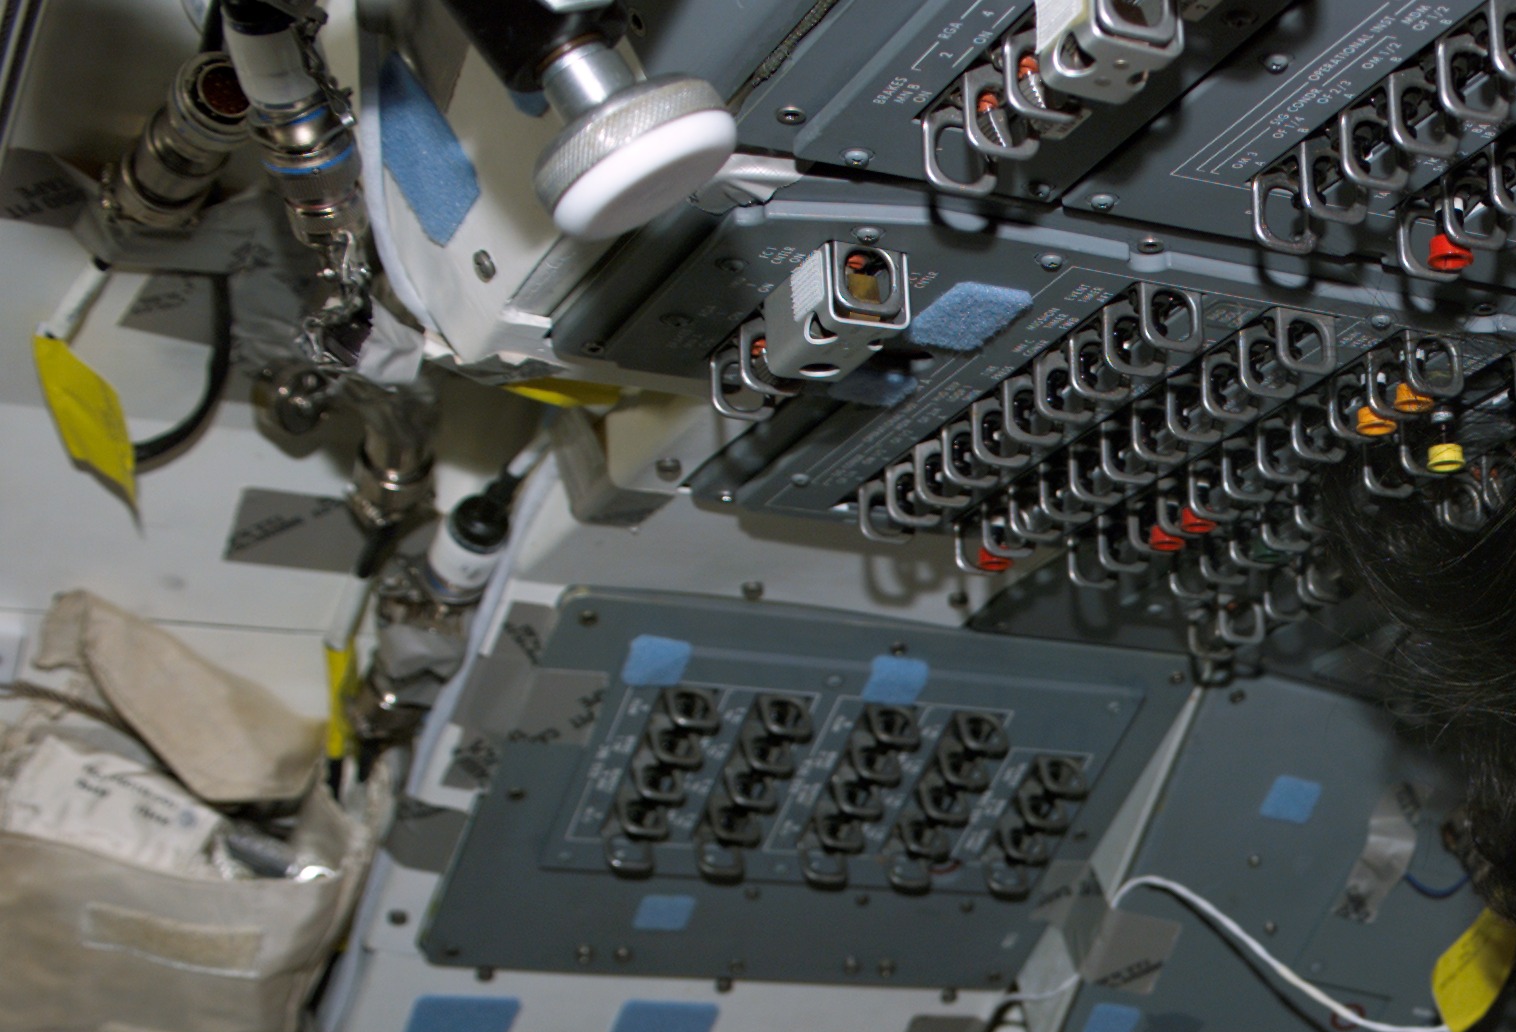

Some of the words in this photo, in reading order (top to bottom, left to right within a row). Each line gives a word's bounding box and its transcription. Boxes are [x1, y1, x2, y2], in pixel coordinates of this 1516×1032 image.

[938, 22, 963, 41] RGA
[1307, 33, 1375, 82] OPERATIONAL
[1369, 15, 1396, 33] INST
[872, 75, 909, 105] BRAKES
